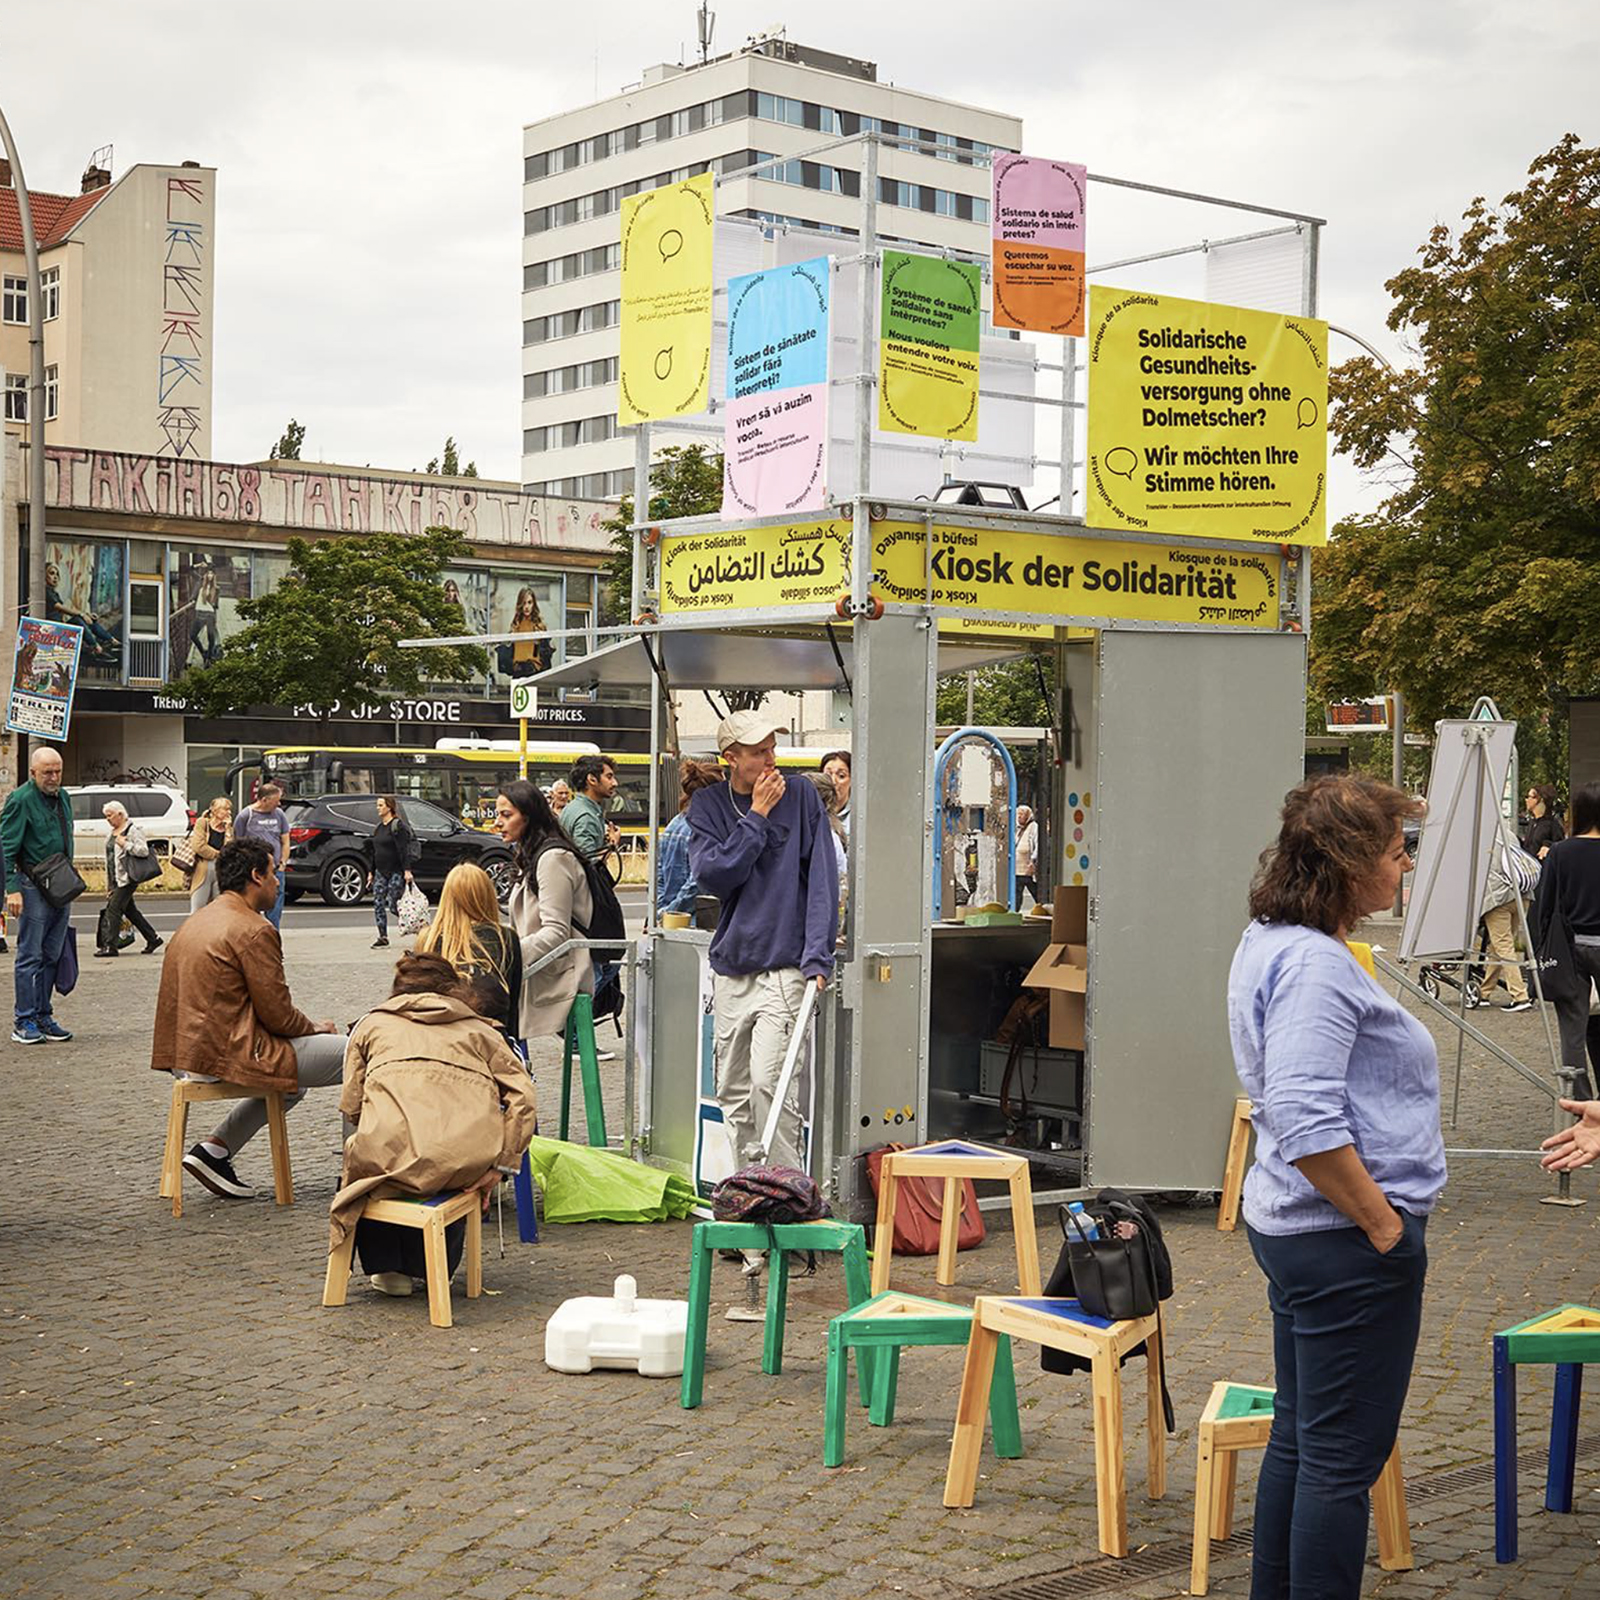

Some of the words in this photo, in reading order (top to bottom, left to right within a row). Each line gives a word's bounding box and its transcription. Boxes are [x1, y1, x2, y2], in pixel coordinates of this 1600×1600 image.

[1001, 208, 1036, 218] Sistema
[1038, 210, 1050, 218] de
[1051, 210, 1074, 219] salud
[1002, 218, 1040, 228] solidario
[1042, 220, 1054, 228] sin
[1056, 220, 1078, 230] intér-
[1002, 230, 1036, 240] pretes?
[1004, 250, 1049, 260] Queremos
[1004, 262, 1044, 270] escuchar
[891, 299, 932, 314] solidaire
[933, 310, 954, 321] sans
[892, 286, 932, 304] Système
[934, 298, 946, 308] de
[948, 302, 972, 316] santé
[1092, 321, 1108, 363] Kiosque
[1104, 310, 1115, 322] de
[1112, 302, 1122, 314] la
[1121, 295, 1159, 309] solidarité
[1138, 327, 1247, 350] Solidarische
[888, 330, 912, 342] Nous
[914, 336, 950, 352] voulons
[734, 350, 761, 370] Sistem
[762, 344, 776, 356] de
[887, 343, 930, 359] entendre
[932, 354, 956, 366] votre
[957, 360, 978, 372] voix.
[1140, 354, 1257, 376] Gesundheits-
[734, 366, 761, 385] solidar
[1141, 383, 1244, 405] versorgung
[1249, 382, 1292, 401] ohne
[736, 415, 758, 428] Vrem
[758, 406, 771, 420] să
[784, 393, 812, 411] auzim
[1142, 408, 1267, 428] Dolmetscher?
[1144, 444, 1178, 466] Wir
[1183, 446, 1261, 466] möchten
[1266, 446, 1299, 465] Ihre
[1090, 454, 1113, 508] Solidarität
[1145, 471, 1215, 494] Stimme
[1220, 472, 1276, 491] hören.
[1308, 472, 1324, 518] Quiosque
[1112, 505, 1125, 518] der
[1125, 515, 1148, 528] Kiosk
[1301, 516, 1310, 526] da
[942, 532, 978, 547] büfesi
[1252, 525, 1301, 538] solidariedade
[665, 539, 688, 568] Kiosk
[688, 540, 702, 552] der
[704, 534, 747, 549] Solidarität
[770, 542, 825, 579] كشك
[688, 551, 765, 594] التضامن
[924, 546, 1014, 585] Kiosk
[1022, 555, 1074, 588] der
[1082, 560, 1237, 600] Solidarität
[1168, 551, 1211, 566] Kiosque
[1213, 554, 1227, 566] de
[1228, 556, 1239, 567] la
[1240, 557, 1276, 598] solidarité
[665, 580, 699, 608] Solidarity
[875, 568, 928, 601] Solidarity
[700, 596, 710, 605] of
[710, 593, 734, 604] Kiosk
[946, 590, 978, 604] Kiosk
[12, 696, 65, 713] BERLIN
[152, 695, 187, 710] TREND
[390, 701, 461, 722] STORE
[549, 708, 586, 722] PRICES.
